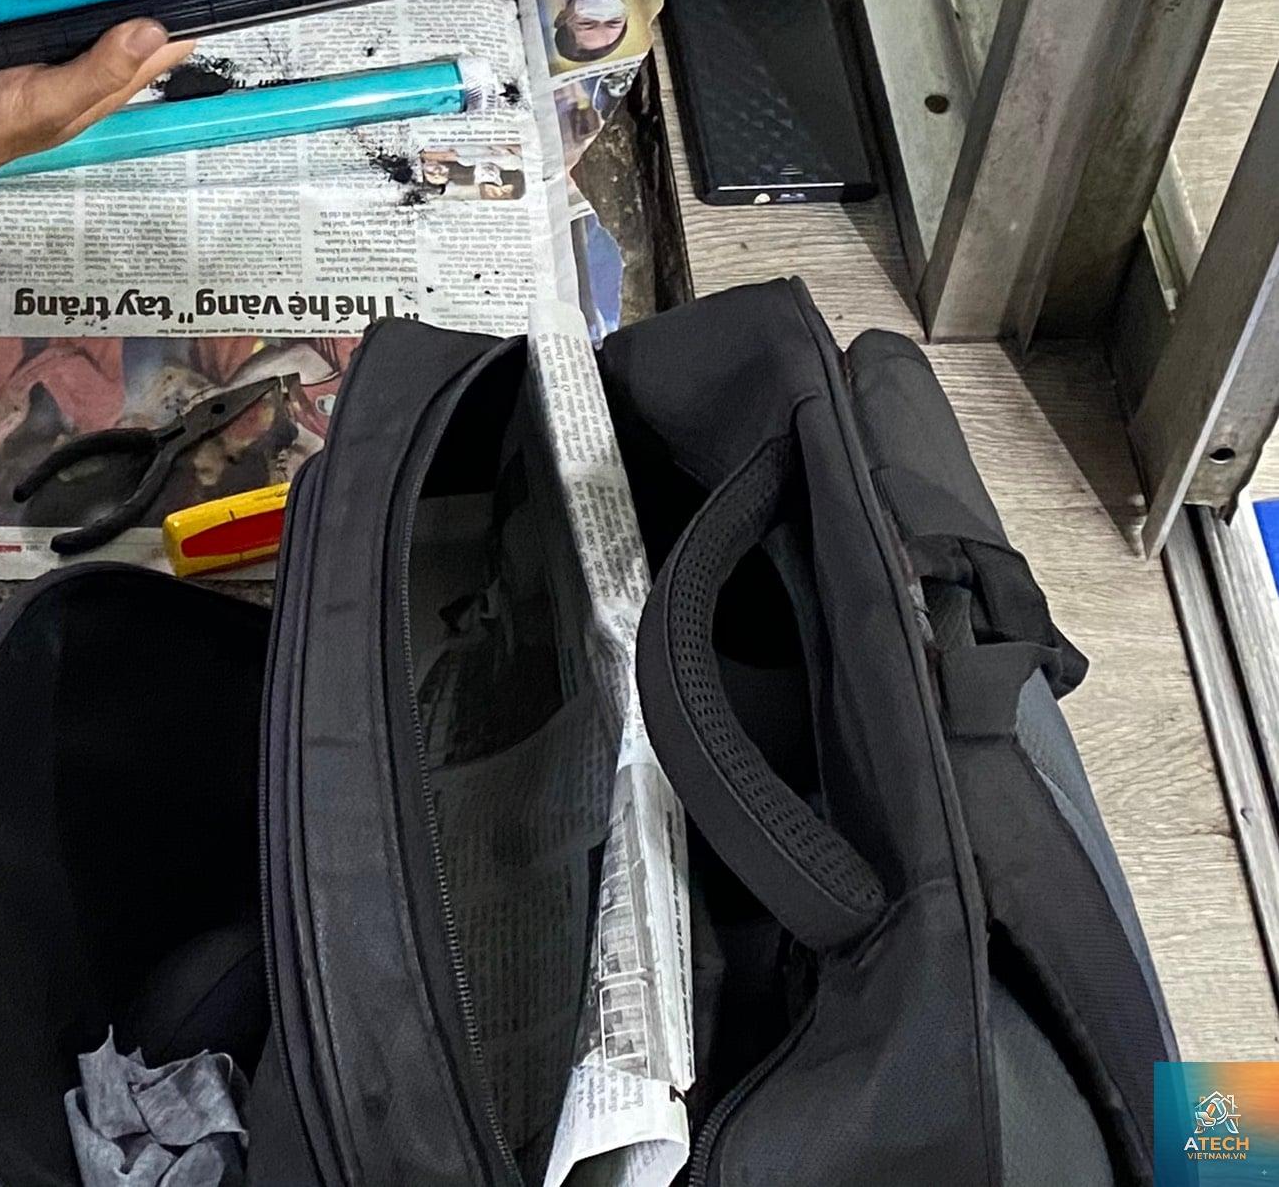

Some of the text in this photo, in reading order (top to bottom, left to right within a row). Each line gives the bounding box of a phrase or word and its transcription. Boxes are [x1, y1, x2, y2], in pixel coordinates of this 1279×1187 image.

[14, 288, 112, 325] trắng
[115, 289, 173, 320] tay
[288, 291, 330, 322] hệ
